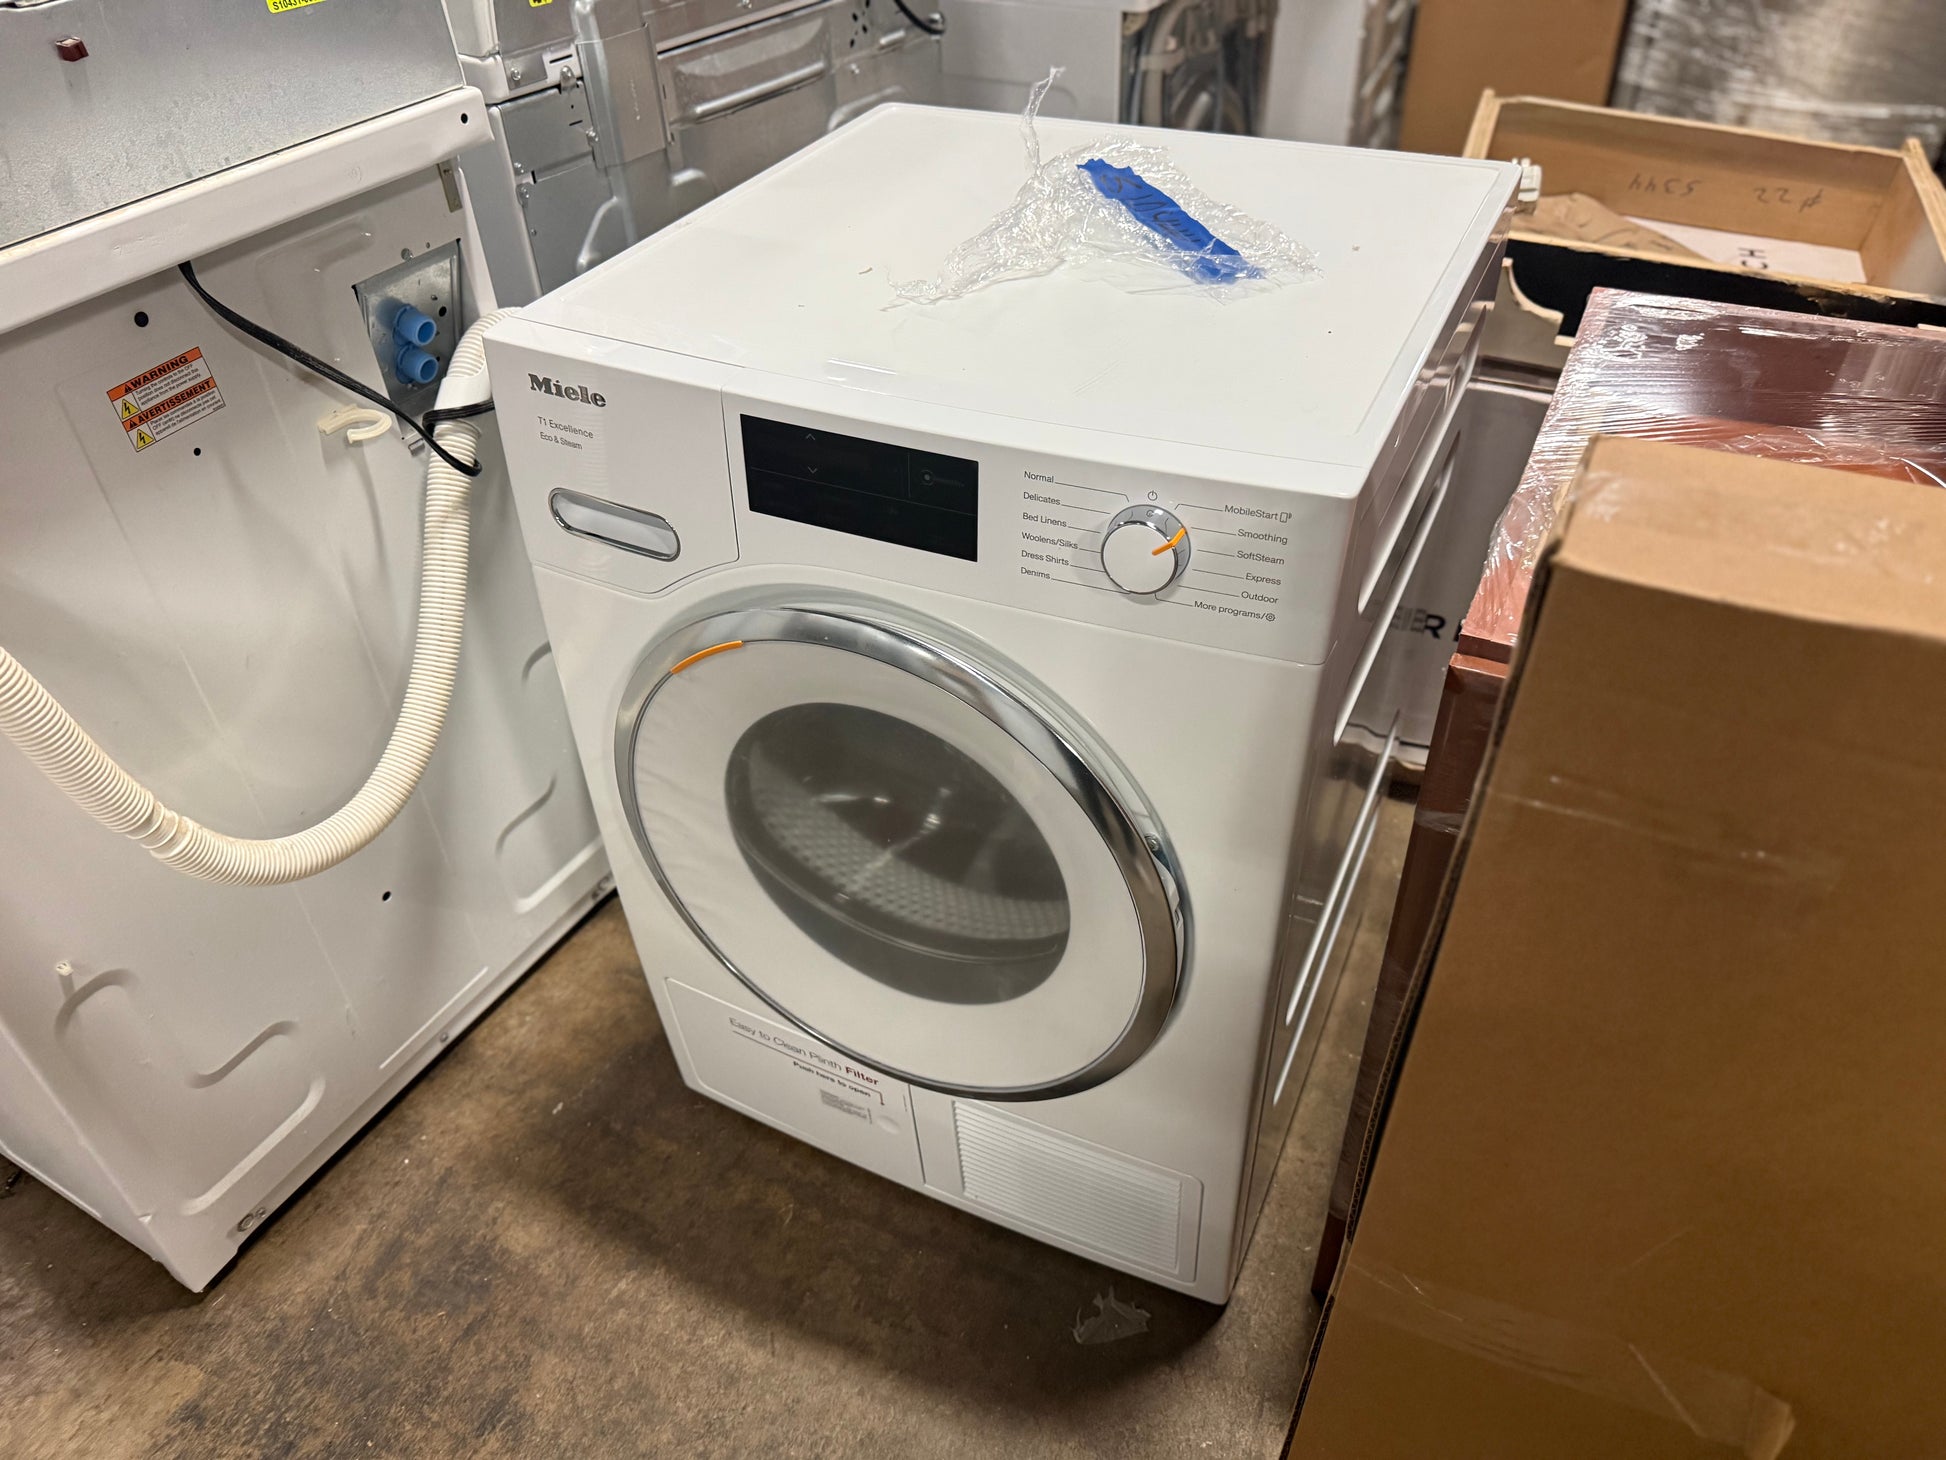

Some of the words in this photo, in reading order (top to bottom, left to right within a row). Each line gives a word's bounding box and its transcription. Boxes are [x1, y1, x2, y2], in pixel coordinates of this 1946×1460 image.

[130, 356, 188, 385] WARNING
[528, 373, 606, 407] Miele
[138, 380, 211, 420] AVERTISSEMENT
[537, 416, 548, 426] T1
[549, 419, 594, 439] Excellence
[540, 432, 554, 442] Eco
[554, 435, 560, 444] &
[560, 437, 583, 450] Steam
[1024, 471, 1055, 483] Normal
[1023, 492, 1061, 505] Delicates
[1022, 512, 1039, 522] Bed
[1040, 516, 1067, 528] Linens
[1224, 505, 1278, 520] MobileStart
[1021, 531, 1079, 550] Woolens/Silks
[1237, 529, 1288, 545] Smoothing
[1021, 550, 1044, 560] Dress
[1045, 555, 1070, 566] Shirts
[1236, 550, 1285, 565] SoftSteam
[1020, 567, 1051, 579] Denims
[1245, 572, 1282, 585] Express
[1194, 600, 1217, 611] More
[1241, 591, 1279, 604] Outdoor
[729, 1017, 756, 1036] Easy
[759, 1031, 771, 1041] to
[773, 1037, 807, 1056] Clean
[809, 1051, 842, 1071] Plinth
[845, 1066, 879, 1085] Filter
[793, 1060, 815, 1074] Push
[816, 1070, 836, 1083] here
[837, 1079, 847, 1088] to
[849, 1085, 871, 1097] open
